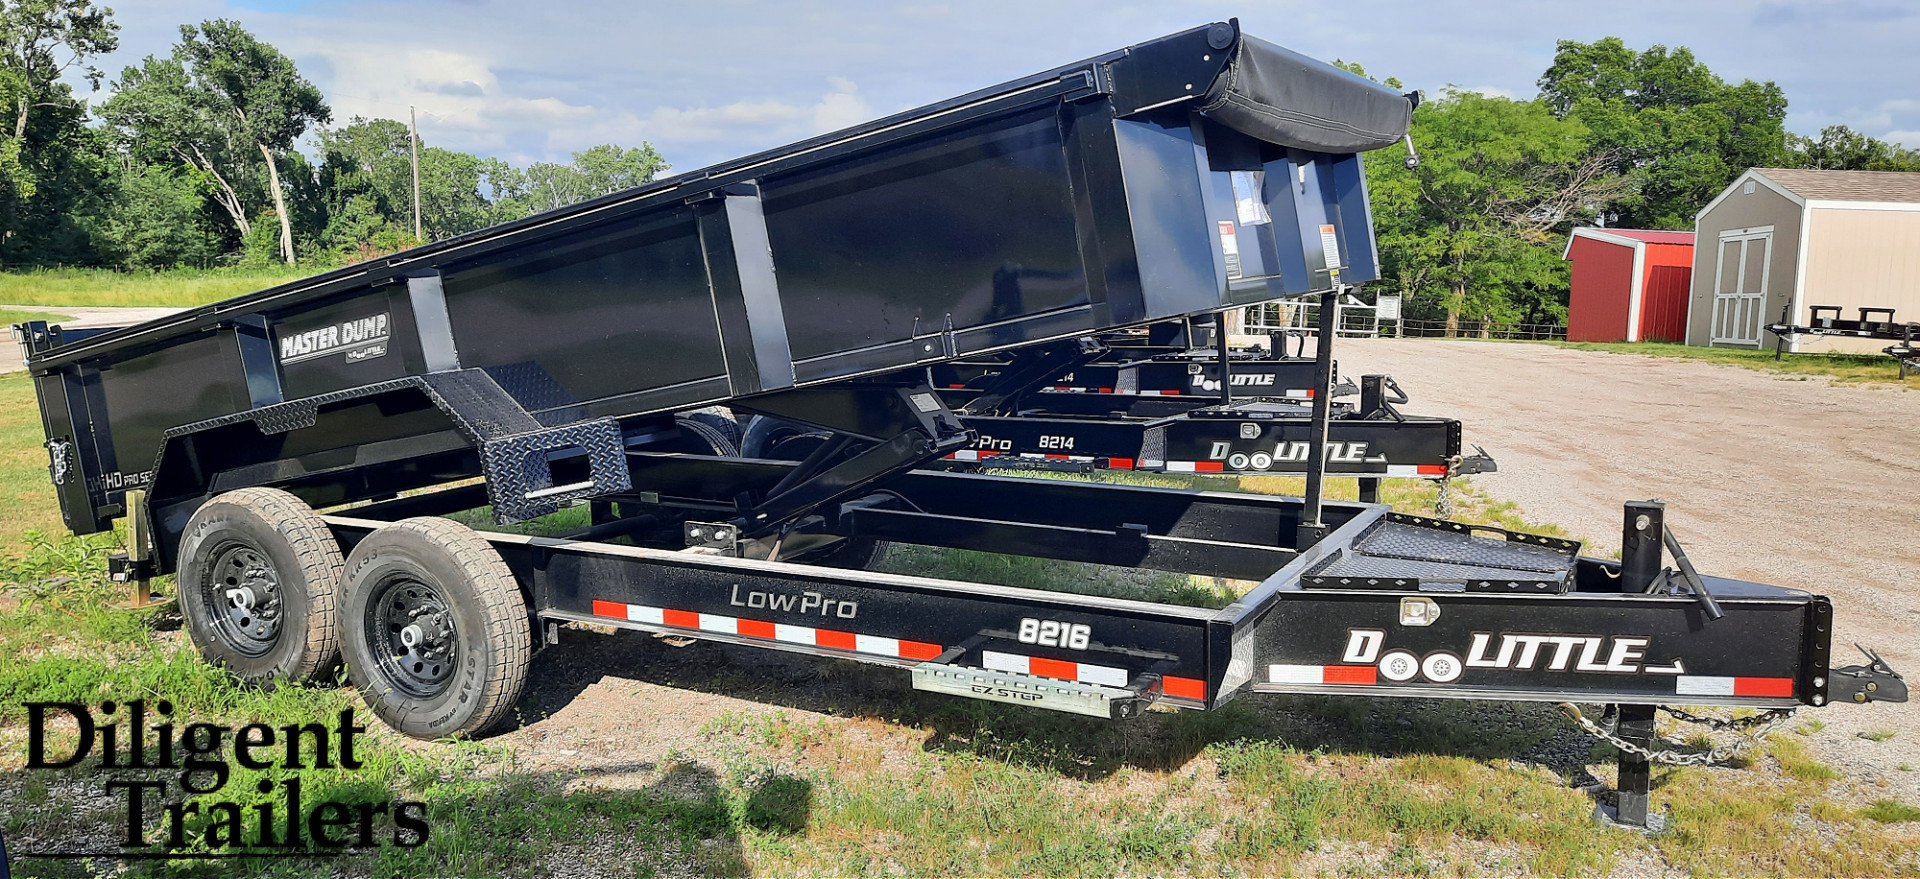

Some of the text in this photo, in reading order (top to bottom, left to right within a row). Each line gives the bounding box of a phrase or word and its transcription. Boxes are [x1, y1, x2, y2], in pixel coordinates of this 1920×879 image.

[281, 325, 339, 359] MASTER
[1039, 435, 1074, 450] 8214
[1210, 441, 1368, 469] DOOLITLE
[123, 473, 139, 486] PRO
[1018, 617, 1092, 651] 8216
[971, 684, 1043, 701] EZ STEP
